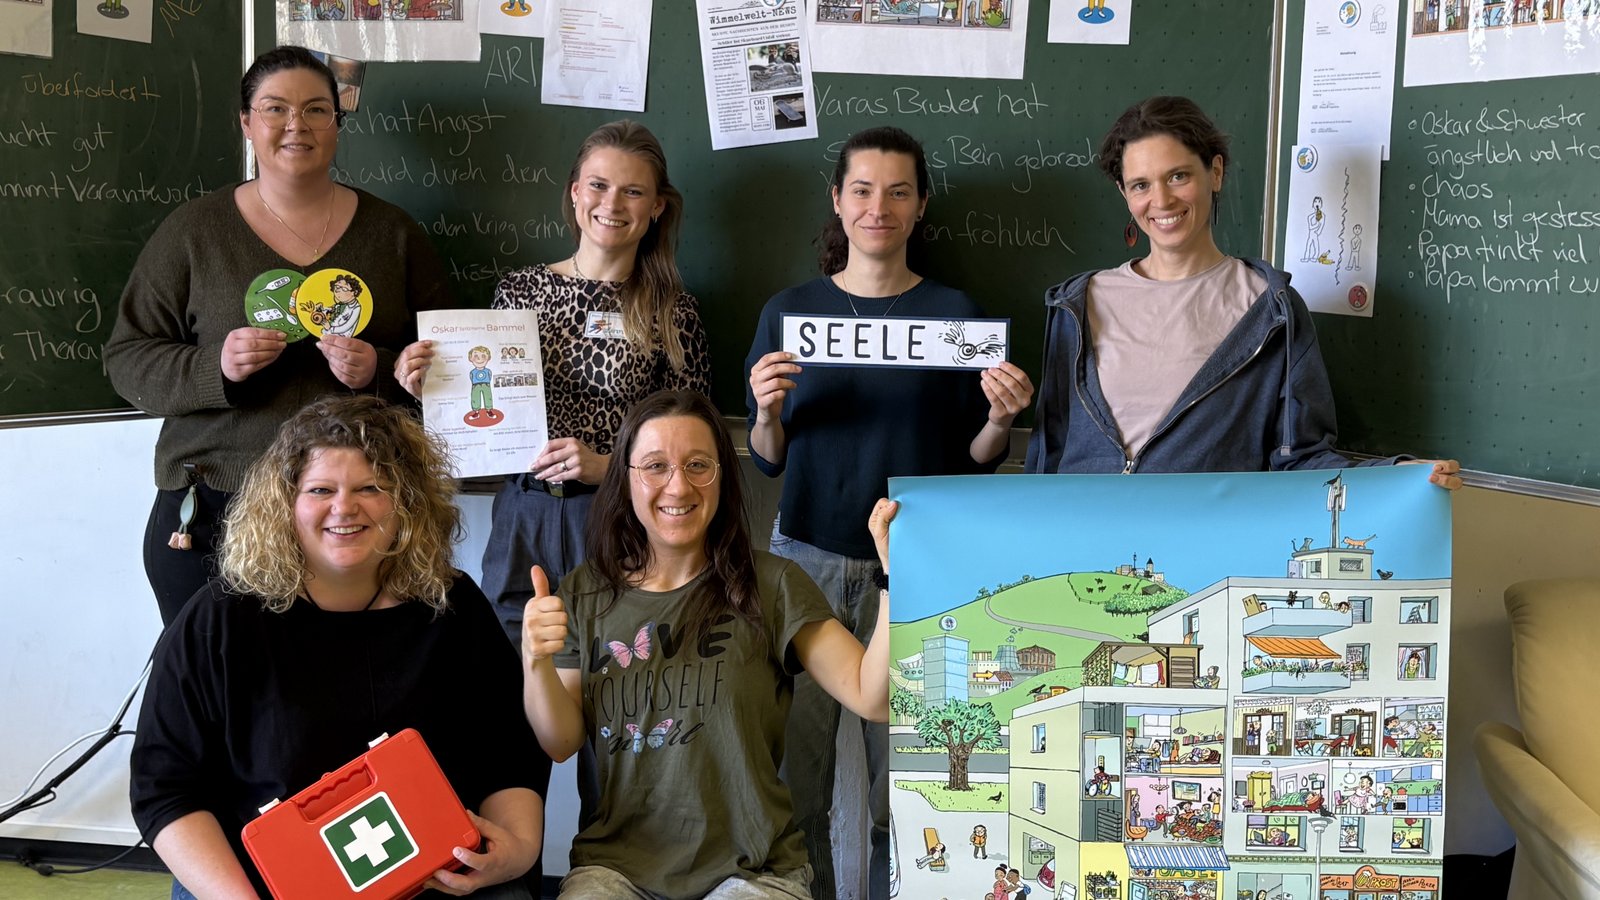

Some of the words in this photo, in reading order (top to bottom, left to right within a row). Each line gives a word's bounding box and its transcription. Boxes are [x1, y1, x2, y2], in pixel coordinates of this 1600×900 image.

[709, 6, 797, 24] Wimmelwelt-NEWS
[893, 86, 984, 115] Bruder
[997, 82, 1049, 119] hat
[366, 99, 415, 134] hat
[417, 98, 507, 156] Angst
[71, 122, 113, 173] gut
[360, 156, 415, 185] wird
[1421, 171, 1494, 200] Chaos
[1422, 197, 1482, 229] Mama
[0, 276, 102, 333] raurig
[431, 325, 459, 334] Oskar
[486, 323, 526, 332] Bammel
[799, 321, 926, 361] SEELE
[587, 660, 725, 722] YOURSELF
